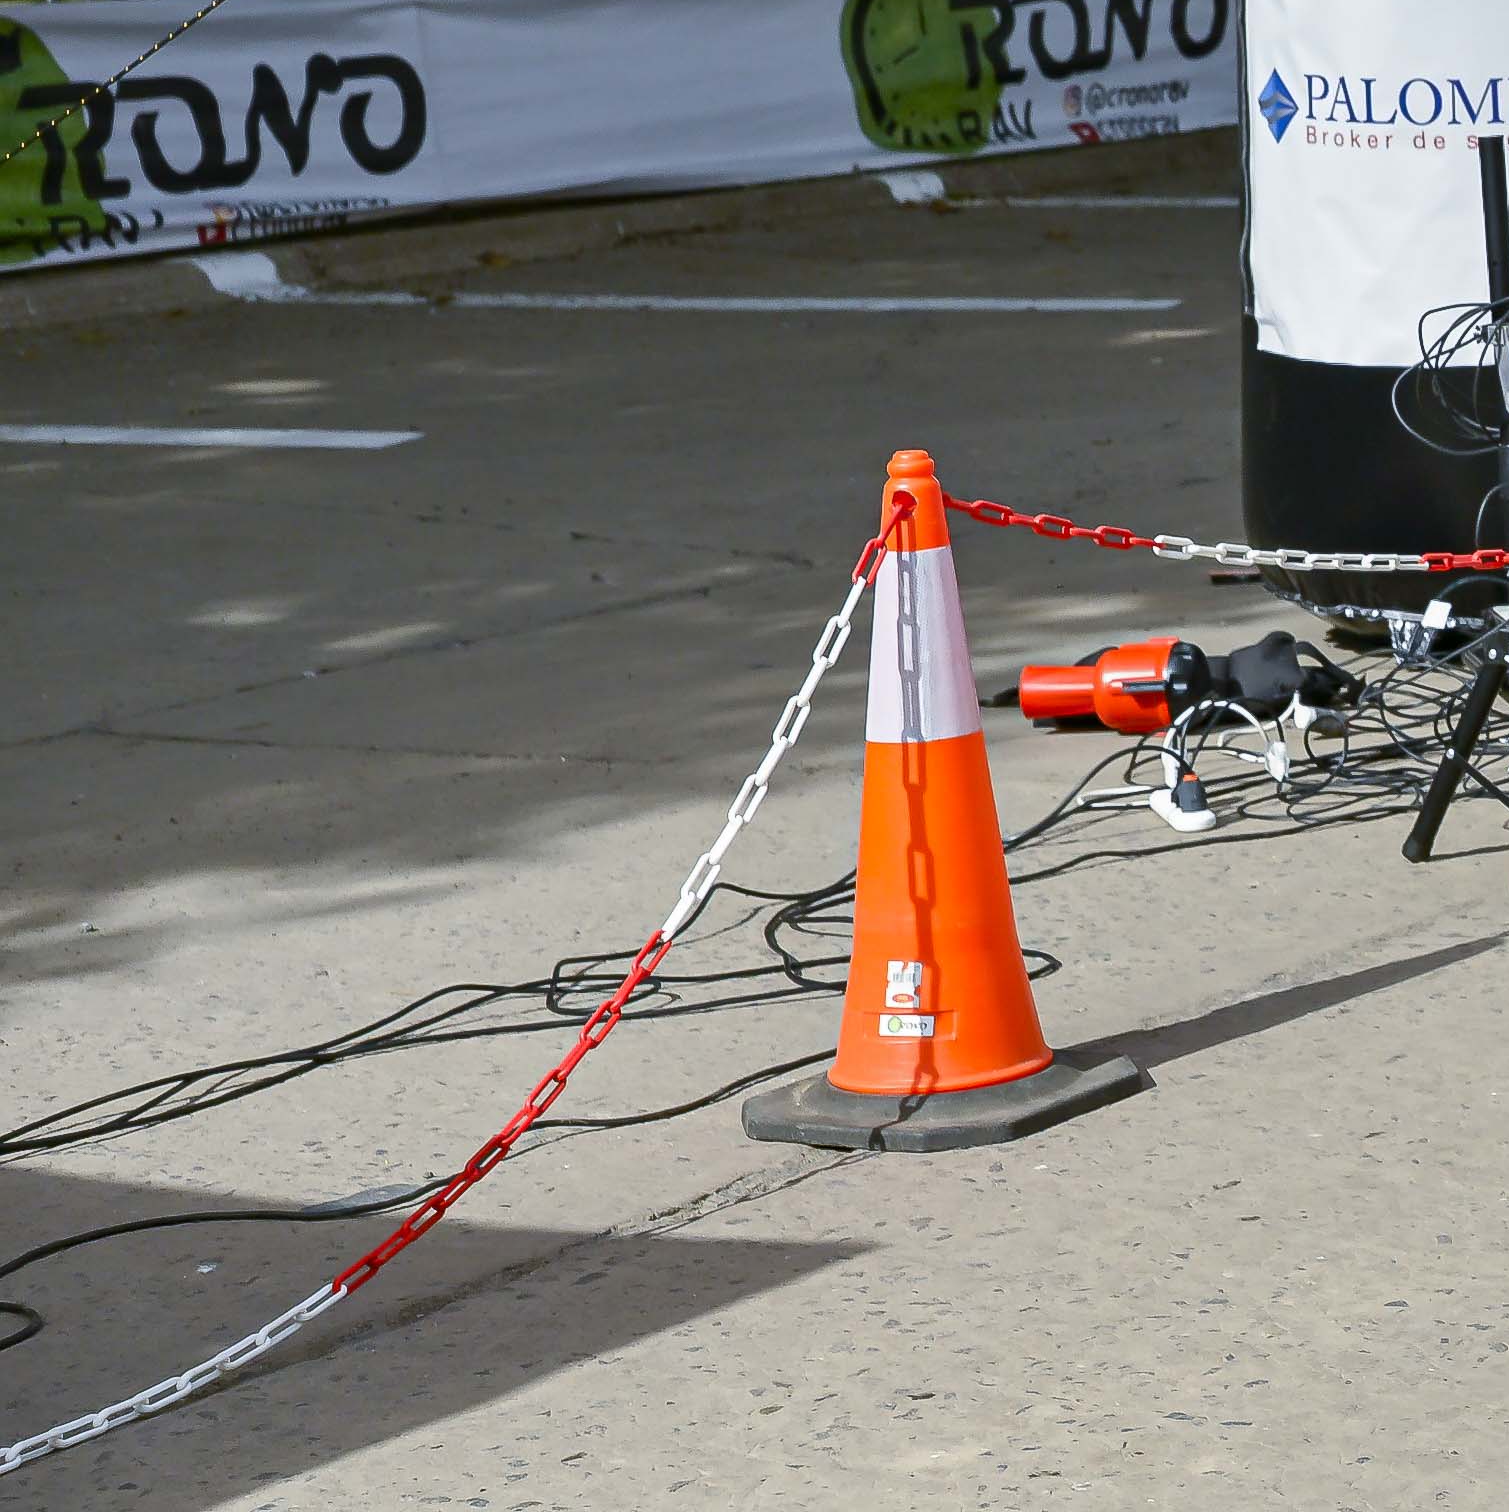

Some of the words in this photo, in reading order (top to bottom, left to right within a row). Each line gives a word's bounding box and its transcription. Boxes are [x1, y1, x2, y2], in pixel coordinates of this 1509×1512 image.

[0, 31, 426, 205] RONO
[1306, 125, 1393, 149] Broker
[1413, 131, 1446, 149] de
